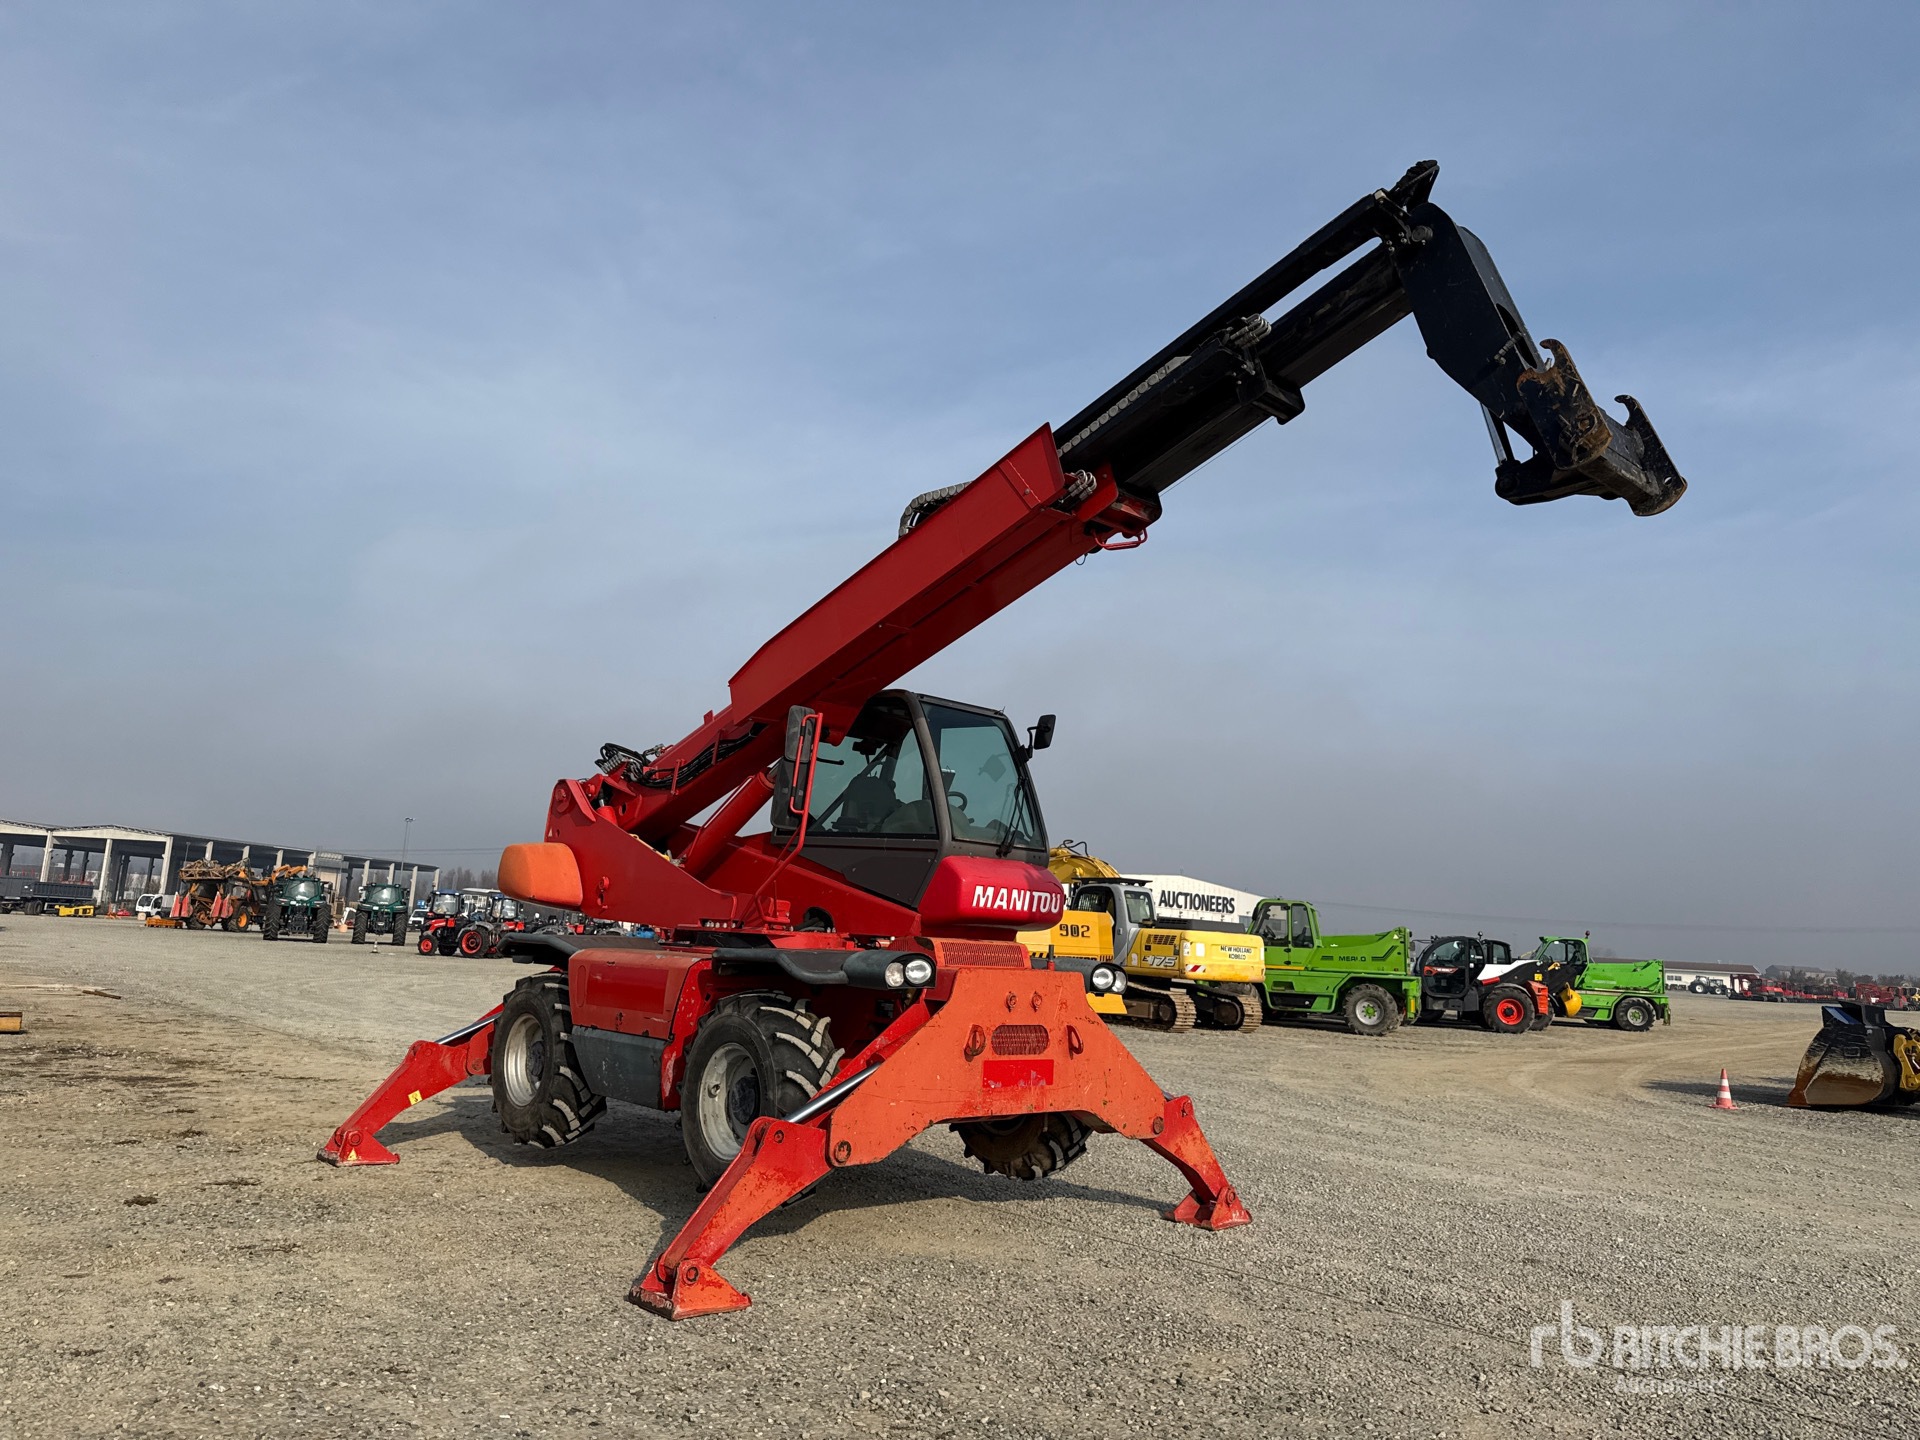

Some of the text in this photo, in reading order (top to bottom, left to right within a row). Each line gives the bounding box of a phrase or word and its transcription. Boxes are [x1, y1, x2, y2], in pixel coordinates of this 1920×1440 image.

[972, 885, 1061, 914] MANITOU
[1158, 889, 1235, 914] AUCTIONEERS
[1059, 923, 1091, 938] 902
